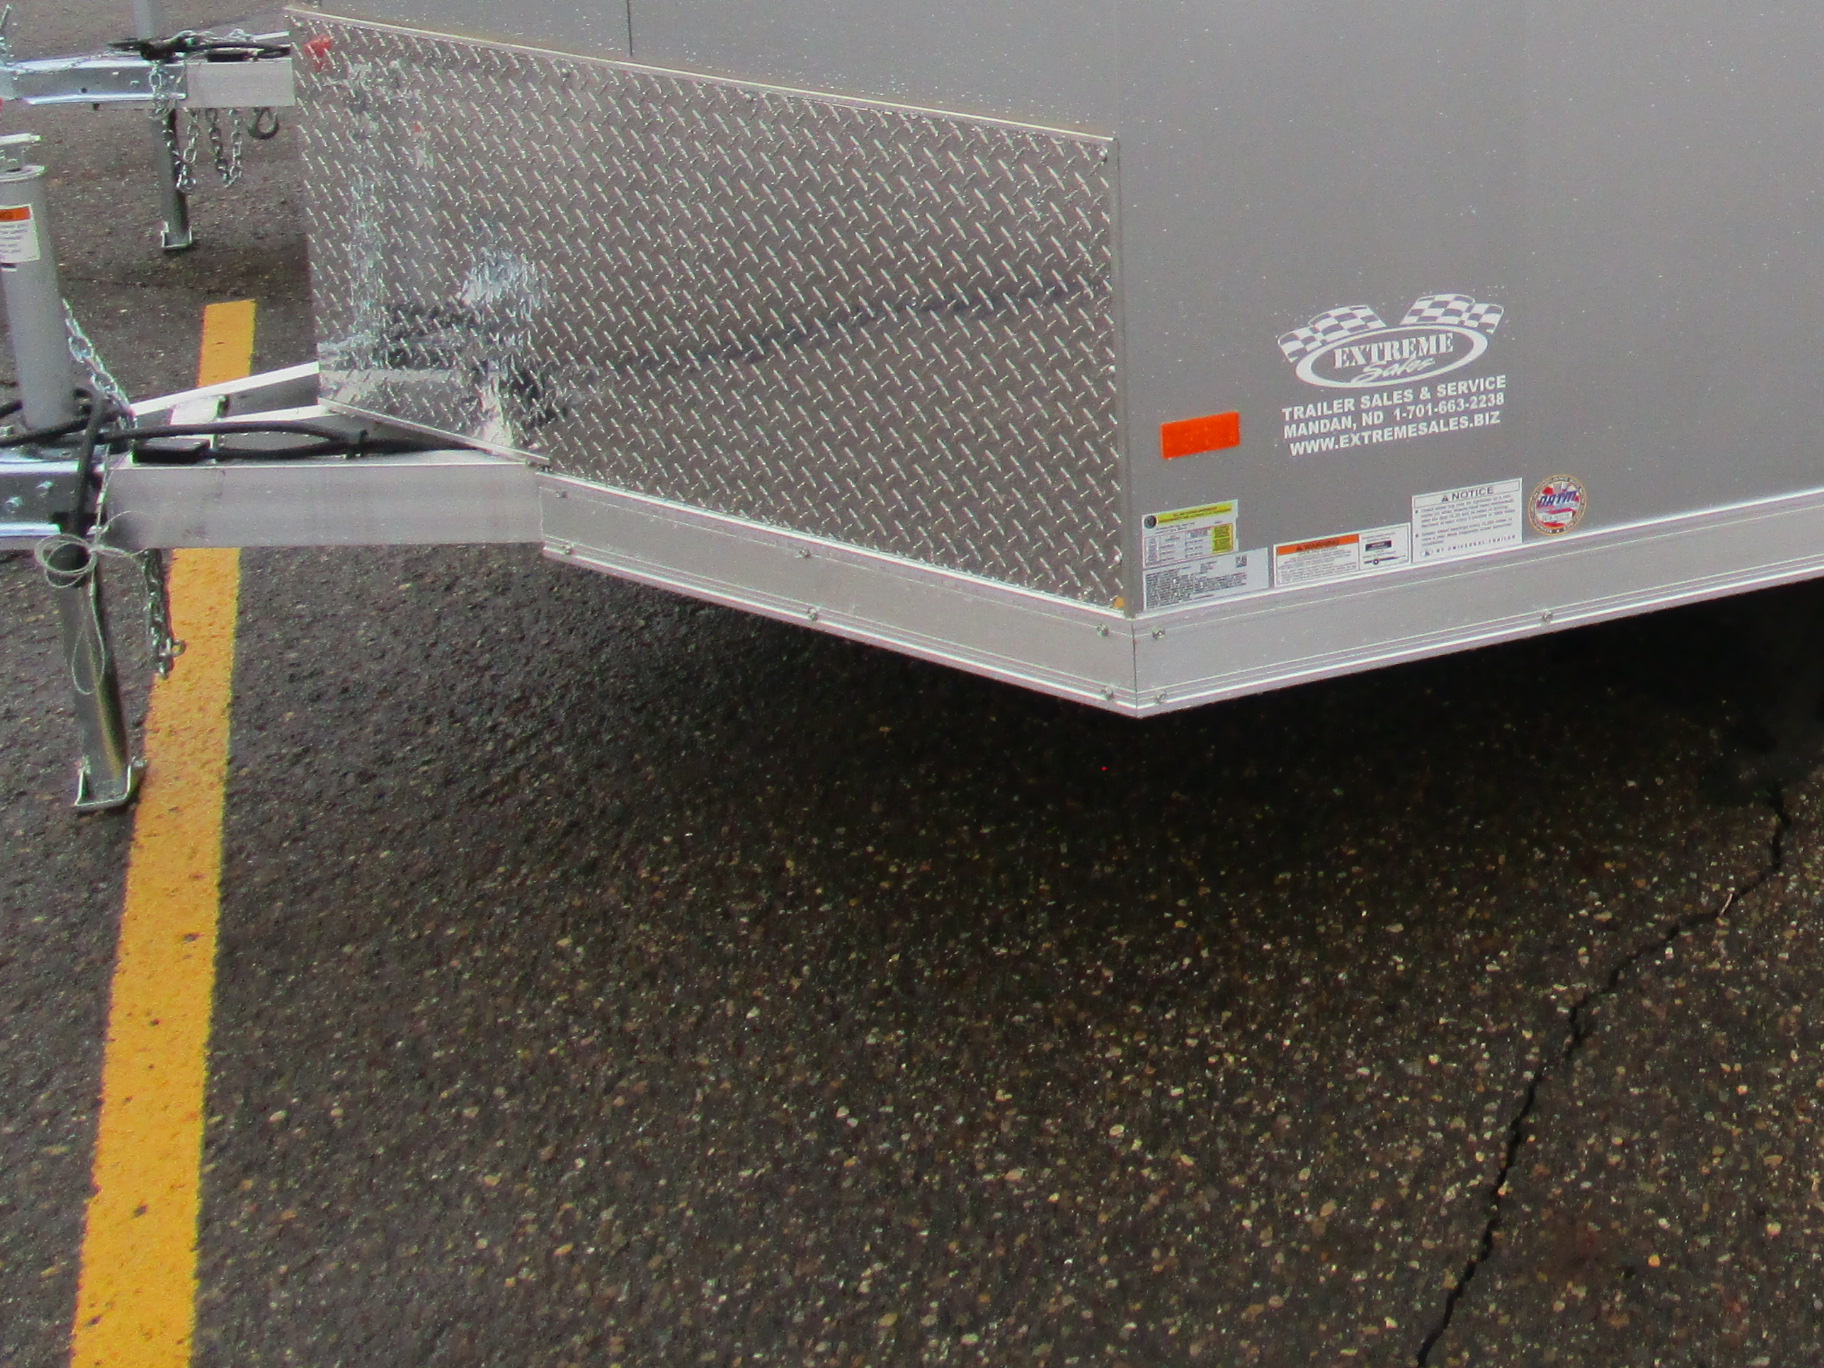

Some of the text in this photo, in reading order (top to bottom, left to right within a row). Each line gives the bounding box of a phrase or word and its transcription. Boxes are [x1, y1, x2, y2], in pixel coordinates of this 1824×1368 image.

[1333, 333, 1454, 368] EXTREME
[1350, 356, 1436, 382] Sales
[1282, 375, 1507, 421] TRAILER SALES & SERVICE
[1283, 392, 1505, 439] MANDAN, ND 1-701-663-2238
[1289, 411, 1501, 457] WWW.EXTREMESALES.BIZ
[1451, 487, 1494, 501] NOTICE
